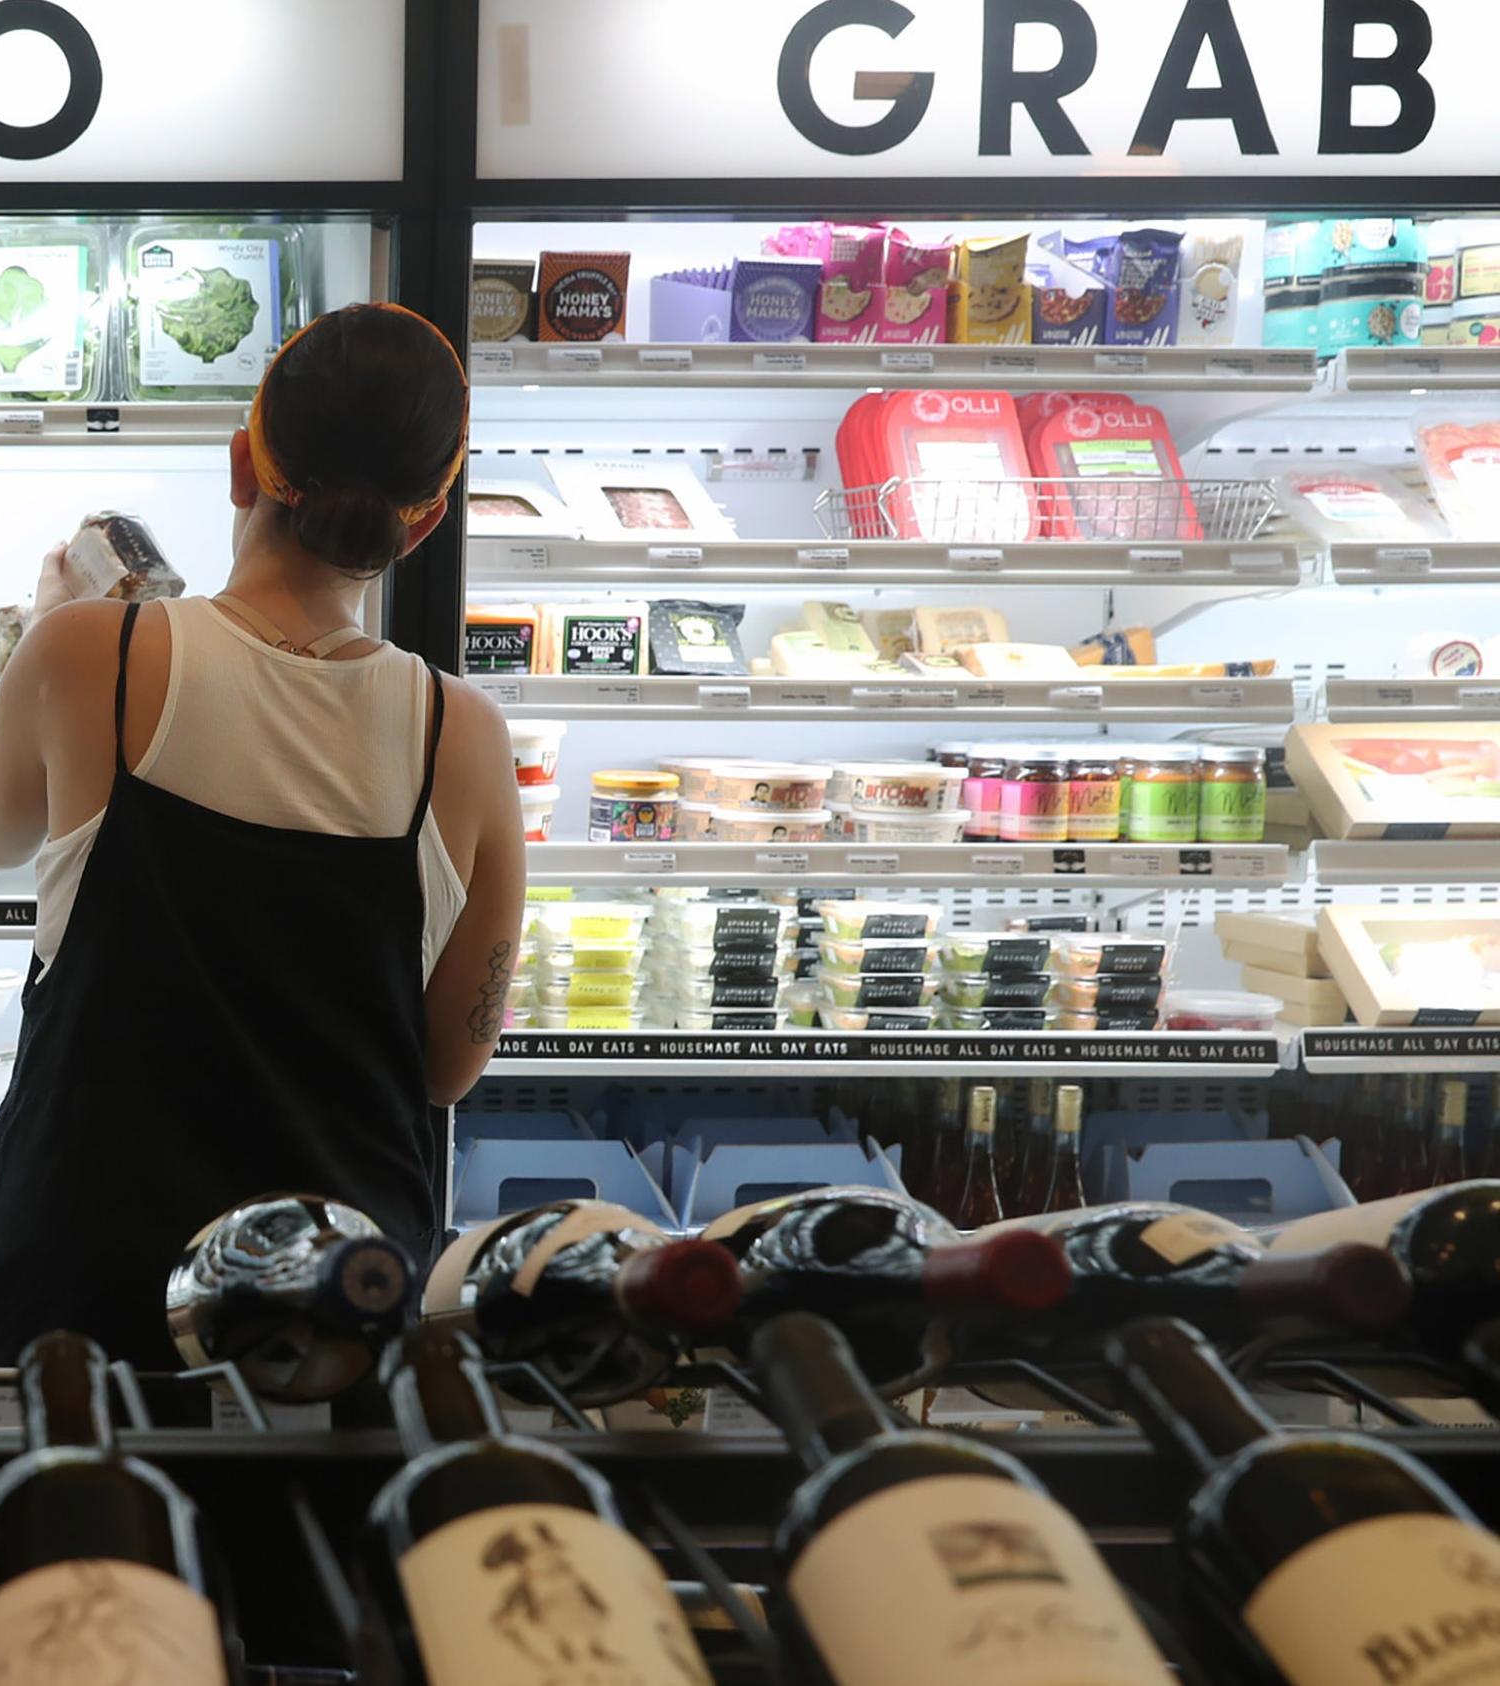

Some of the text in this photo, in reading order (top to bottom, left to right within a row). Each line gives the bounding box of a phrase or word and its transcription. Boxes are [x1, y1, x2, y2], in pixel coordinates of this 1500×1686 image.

[777, 0, 1436, 156] GRAB
[473, 293, 513, 305] ONEY
[560, 293, 610, 305] HONEY
[750, 294, 799, 306] HONEY
[556, 305, 612, 318] MAMA'S
[746, 306, 801, 319] MAMA'S
[951, 398, 1000, 413] OLLI
[1103, 412, 1152, 428] OLLI
[572, 625, 632, 641] HOOK'S
[6, 909, 27, 920] ALL
[537, 1042, 560, 1053] ALL
[569, 1042, 593, 1053] DAY
[602, 1042, 634, 1053] EATS
[661, 1042, 740, 1053] HOUSEMADE
[750, 1042, 772, 1053] ALL
[782, 1042, 806, 1053] DAY
[815, 1043, 847, 1054] EATS
[871, 1044, 1265, 1056] HOUSEMADE ALL DAY EATS HOUSEMADE ALL DAY EATS
[1315, 1038, 1499, 1051] HOUSEMADE ALL DAY EATS
